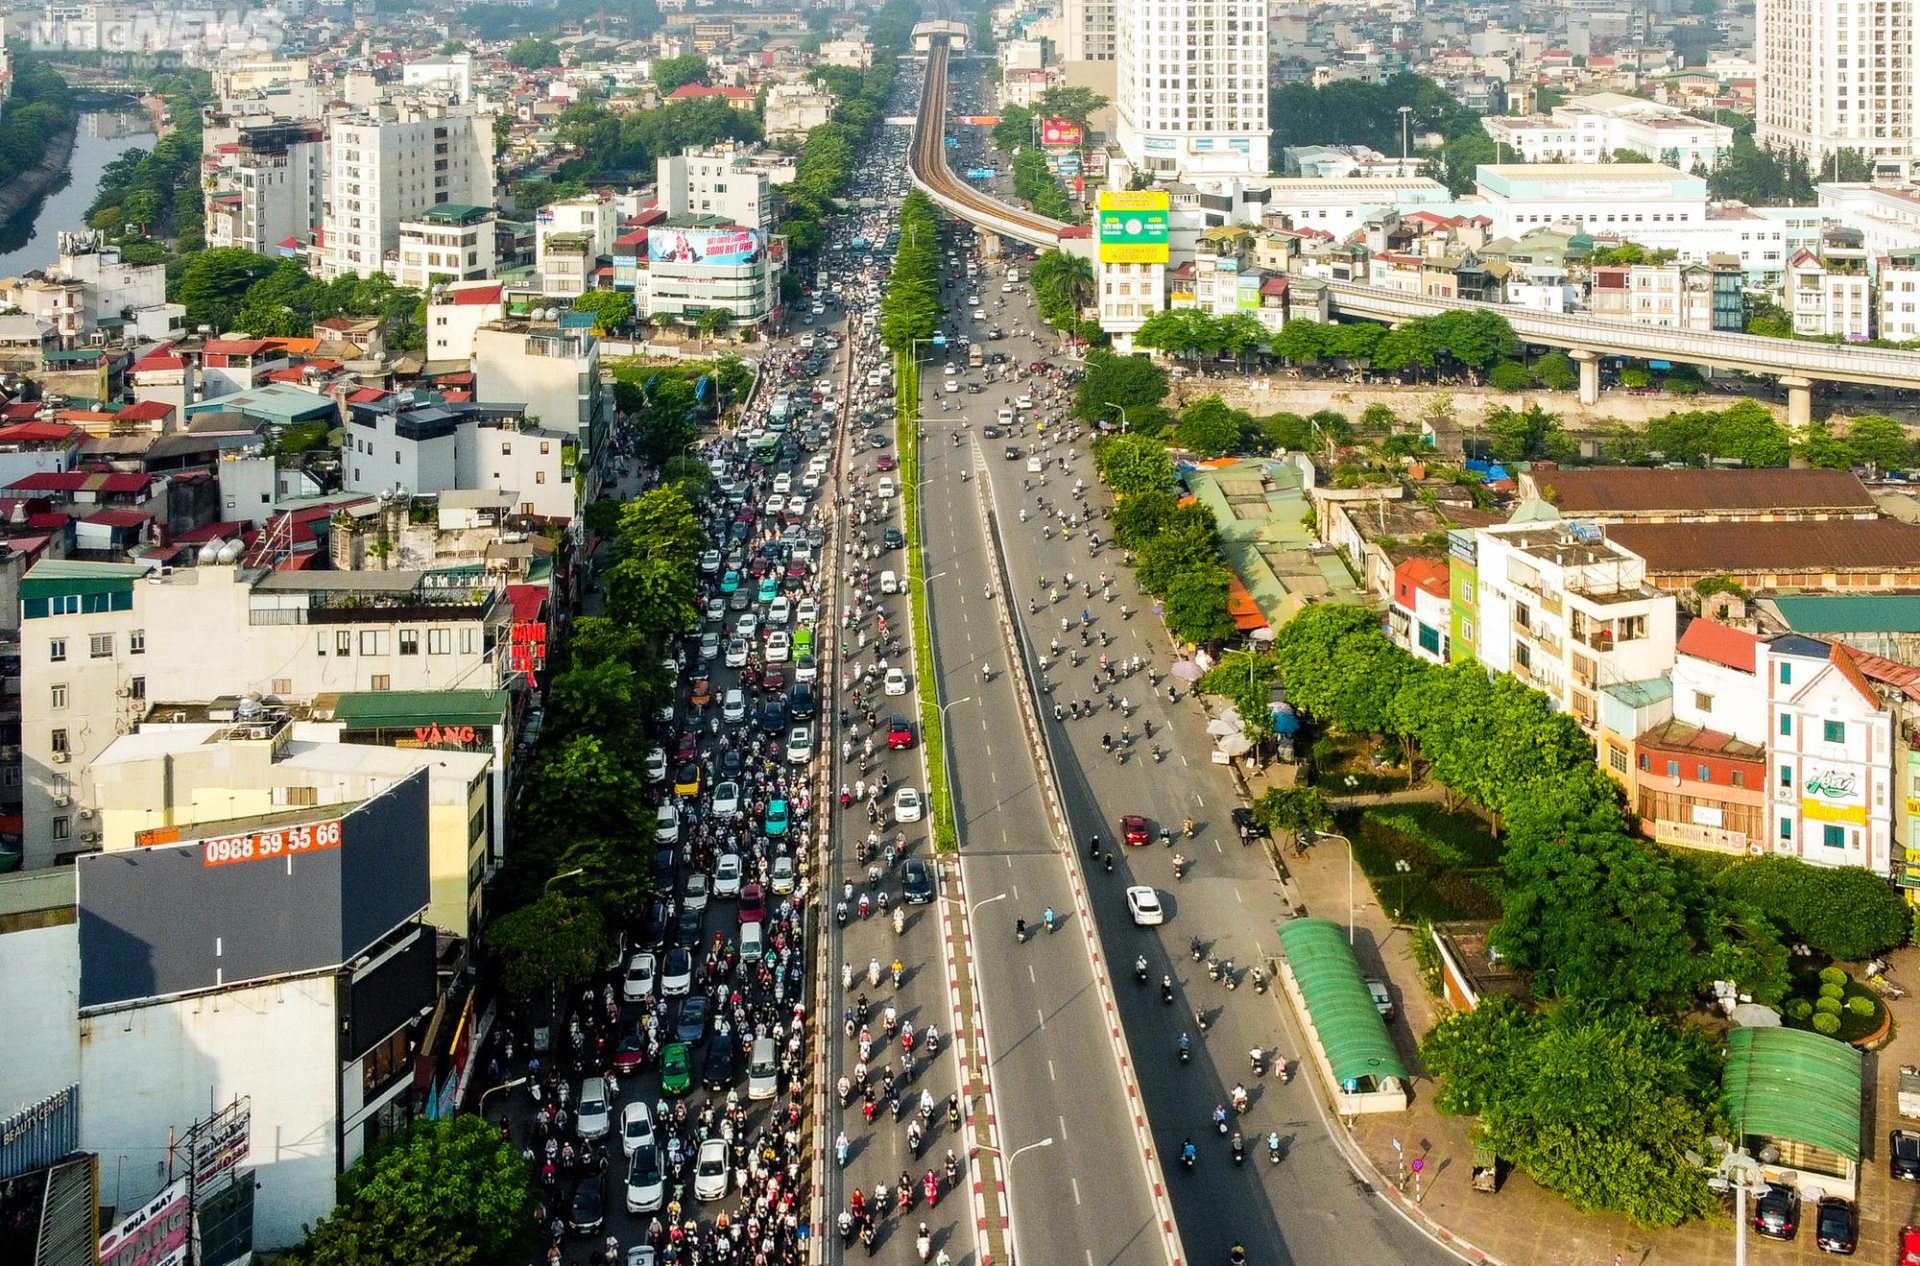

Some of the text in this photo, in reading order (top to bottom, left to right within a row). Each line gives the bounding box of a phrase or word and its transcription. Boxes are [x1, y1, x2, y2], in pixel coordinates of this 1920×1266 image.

[415, 721, 475, 743] VÀNG
[206, 822, 339, 862] 0988 59 55 66
[3, 1091, 69, 1146] BEAUTY CENTER
[150, 1191, 174, 1217] MAY
